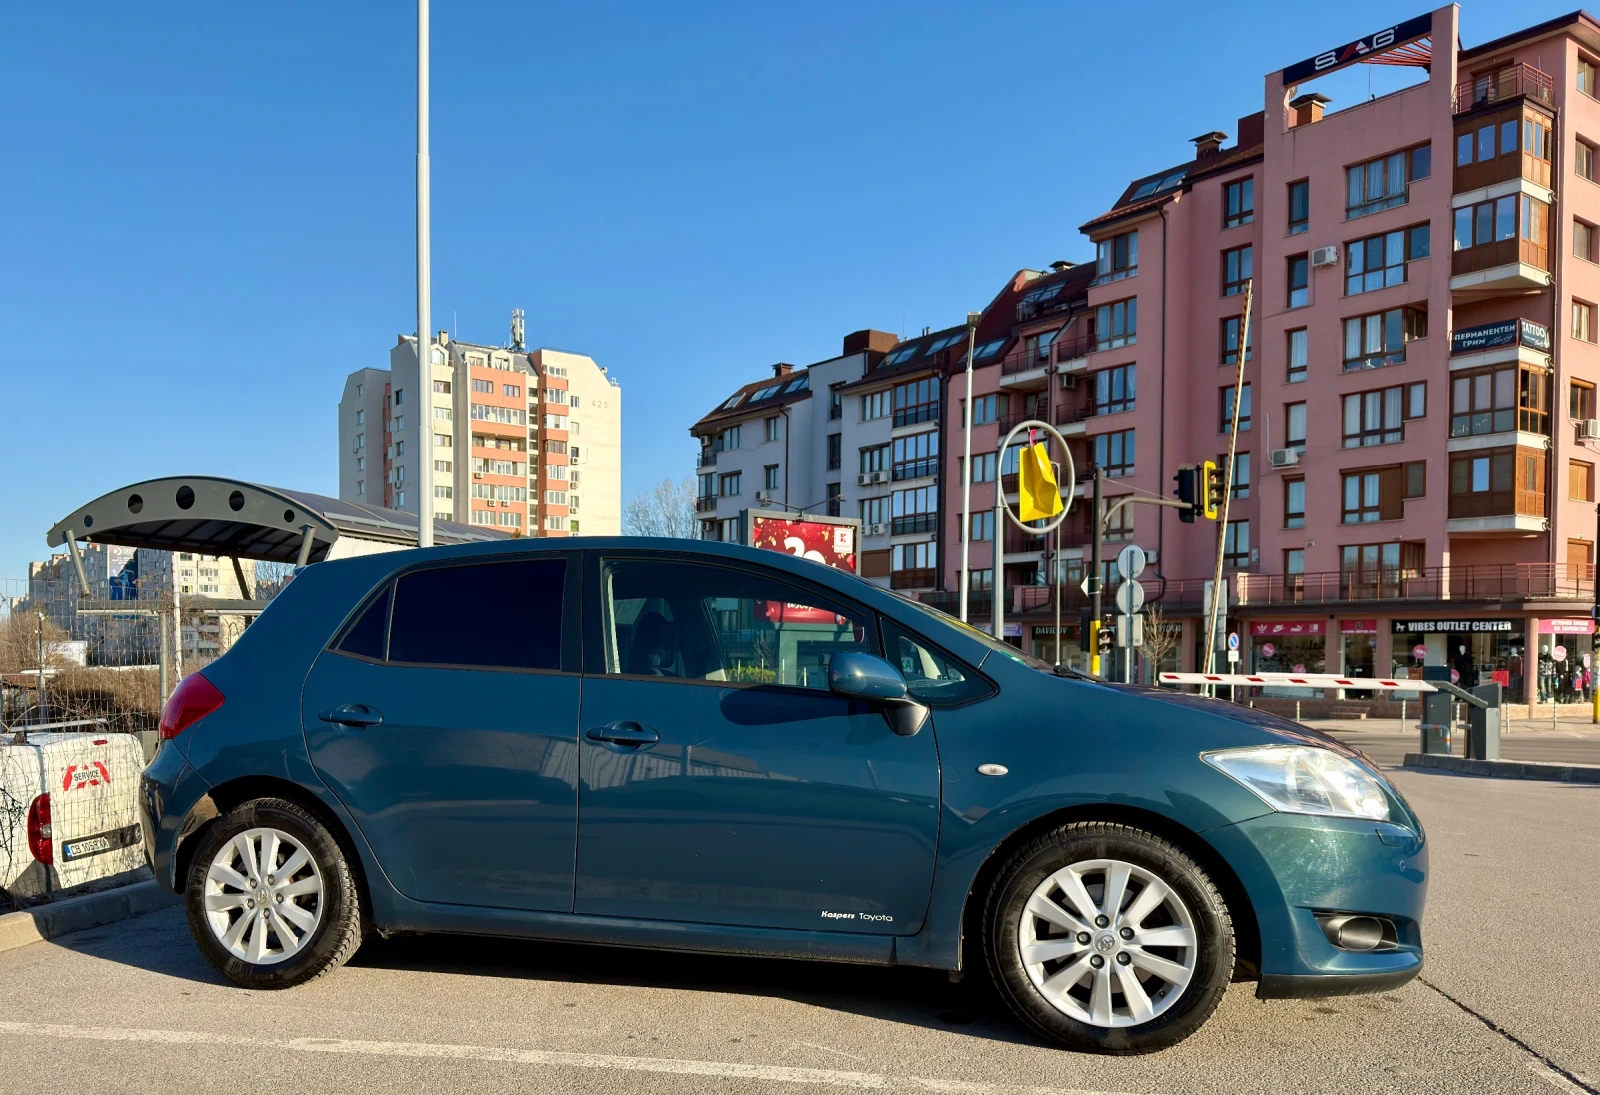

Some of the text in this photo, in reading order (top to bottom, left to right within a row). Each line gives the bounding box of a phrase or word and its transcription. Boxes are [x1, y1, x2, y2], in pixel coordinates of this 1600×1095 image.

[1455, 325, 1516, 341] ПЕРМАНЕНТЕН
[1521, 321, 1545, 338] TATTOO
[1462, 338, 1486, 348] ГРИМ
[591, 400, 608, 409] 423
[1408, 621, 1512, 631] VIBES OUTLET CENTER
[74, 769, 99, 781] SERVICE
[821, 910, 893, 921] Kaspers Toyota
